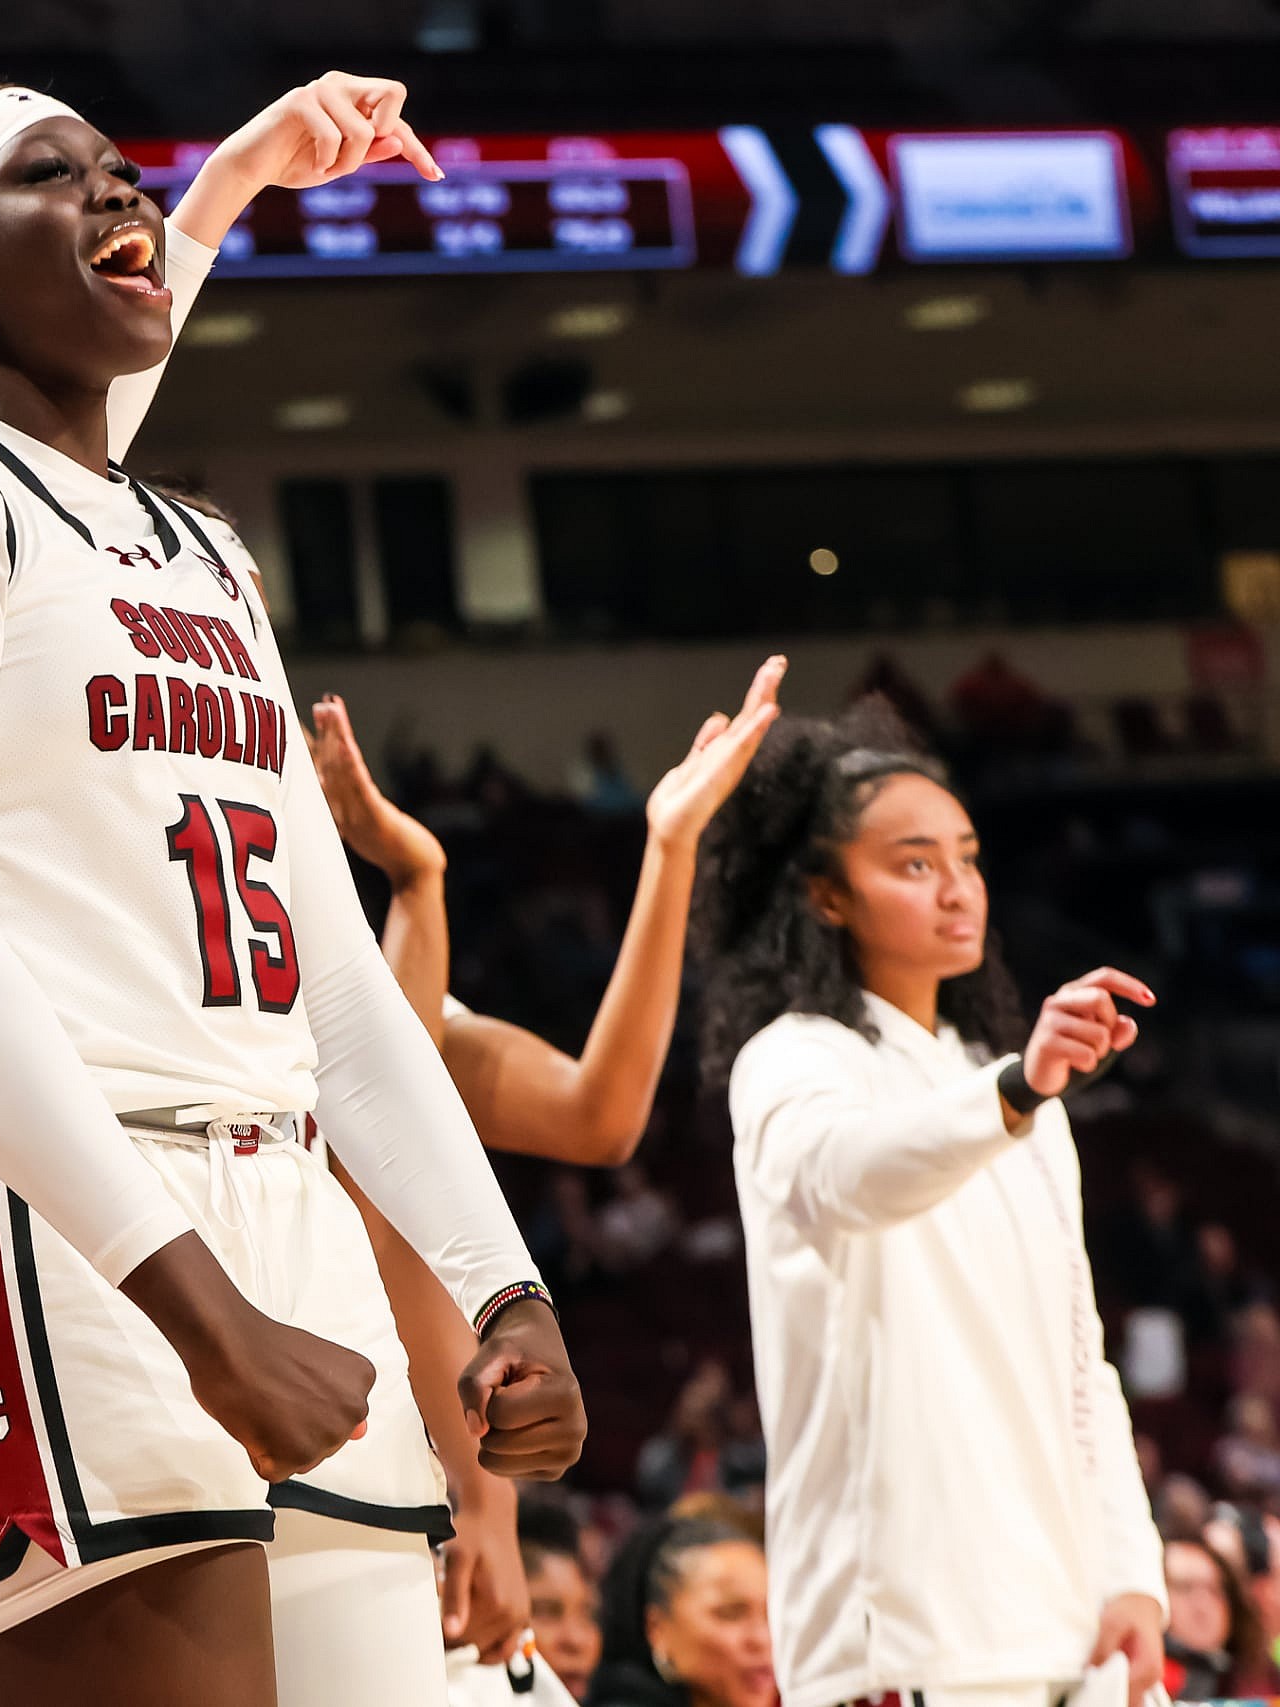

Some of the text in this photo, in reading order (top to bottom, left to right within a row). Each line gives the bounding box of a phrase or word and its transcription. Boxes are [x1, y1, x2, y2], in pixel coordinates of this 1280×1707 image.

[110, 598, 261, 682] SOUTH
[85, 674, 287, 781] CAROLIN
[165, 793, 300, 1015] 15
